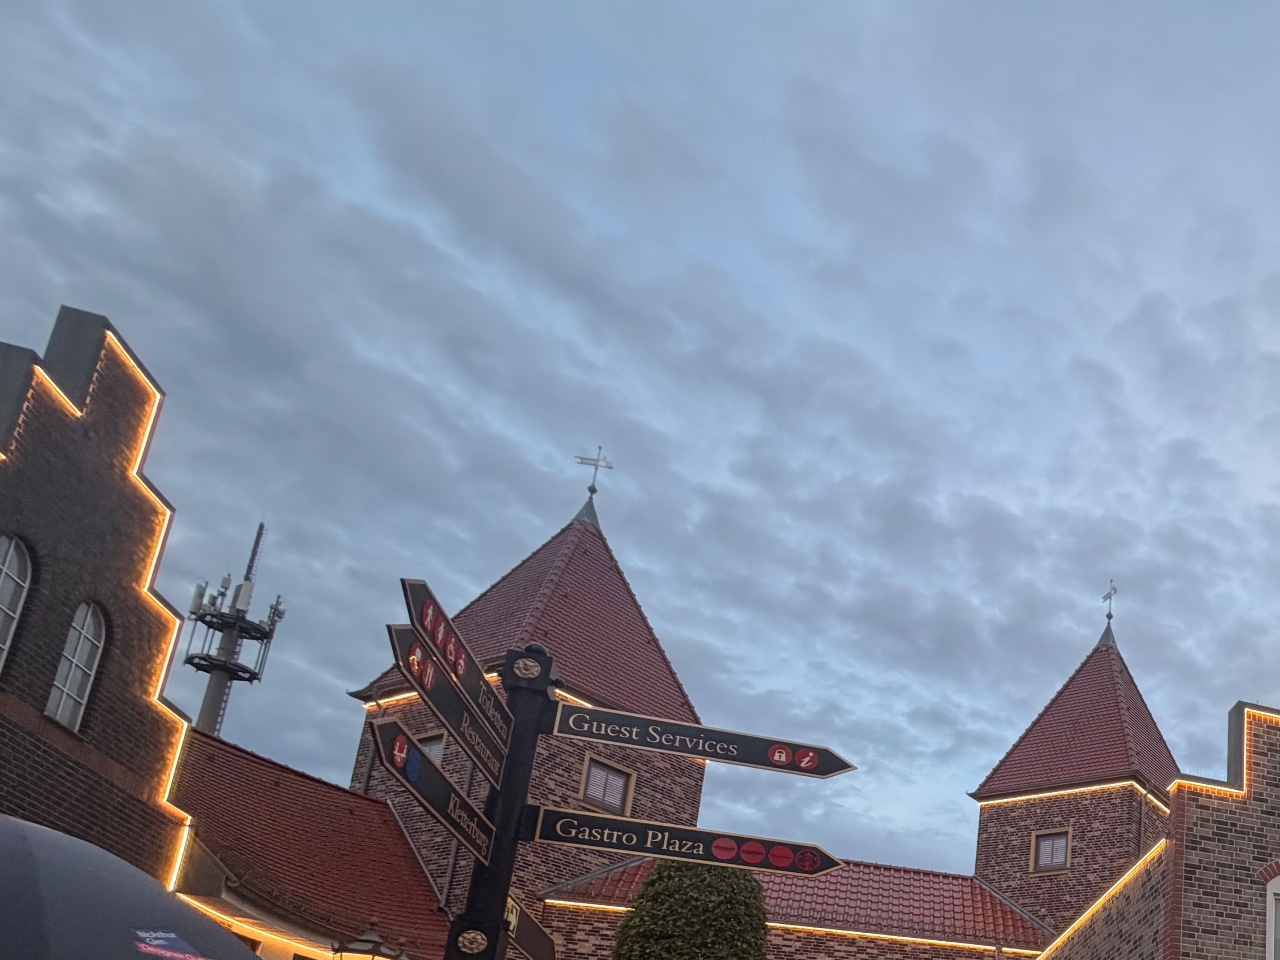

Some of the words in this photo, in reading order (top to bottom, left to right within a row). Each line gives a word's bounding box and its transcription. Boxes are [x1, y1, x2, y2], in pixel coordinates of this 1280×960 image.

[478, 680, 508, 740] Toiletten
[568, 713, 640, 740] Guest
[646, 725, 738, 756] Services
[460, 710, 500, 776] Restaurant
[447, 792, 489, 856] Kletterburg
[556, 818, 637, 846] Gastro
[644, 829, 705, 855] Plaza
